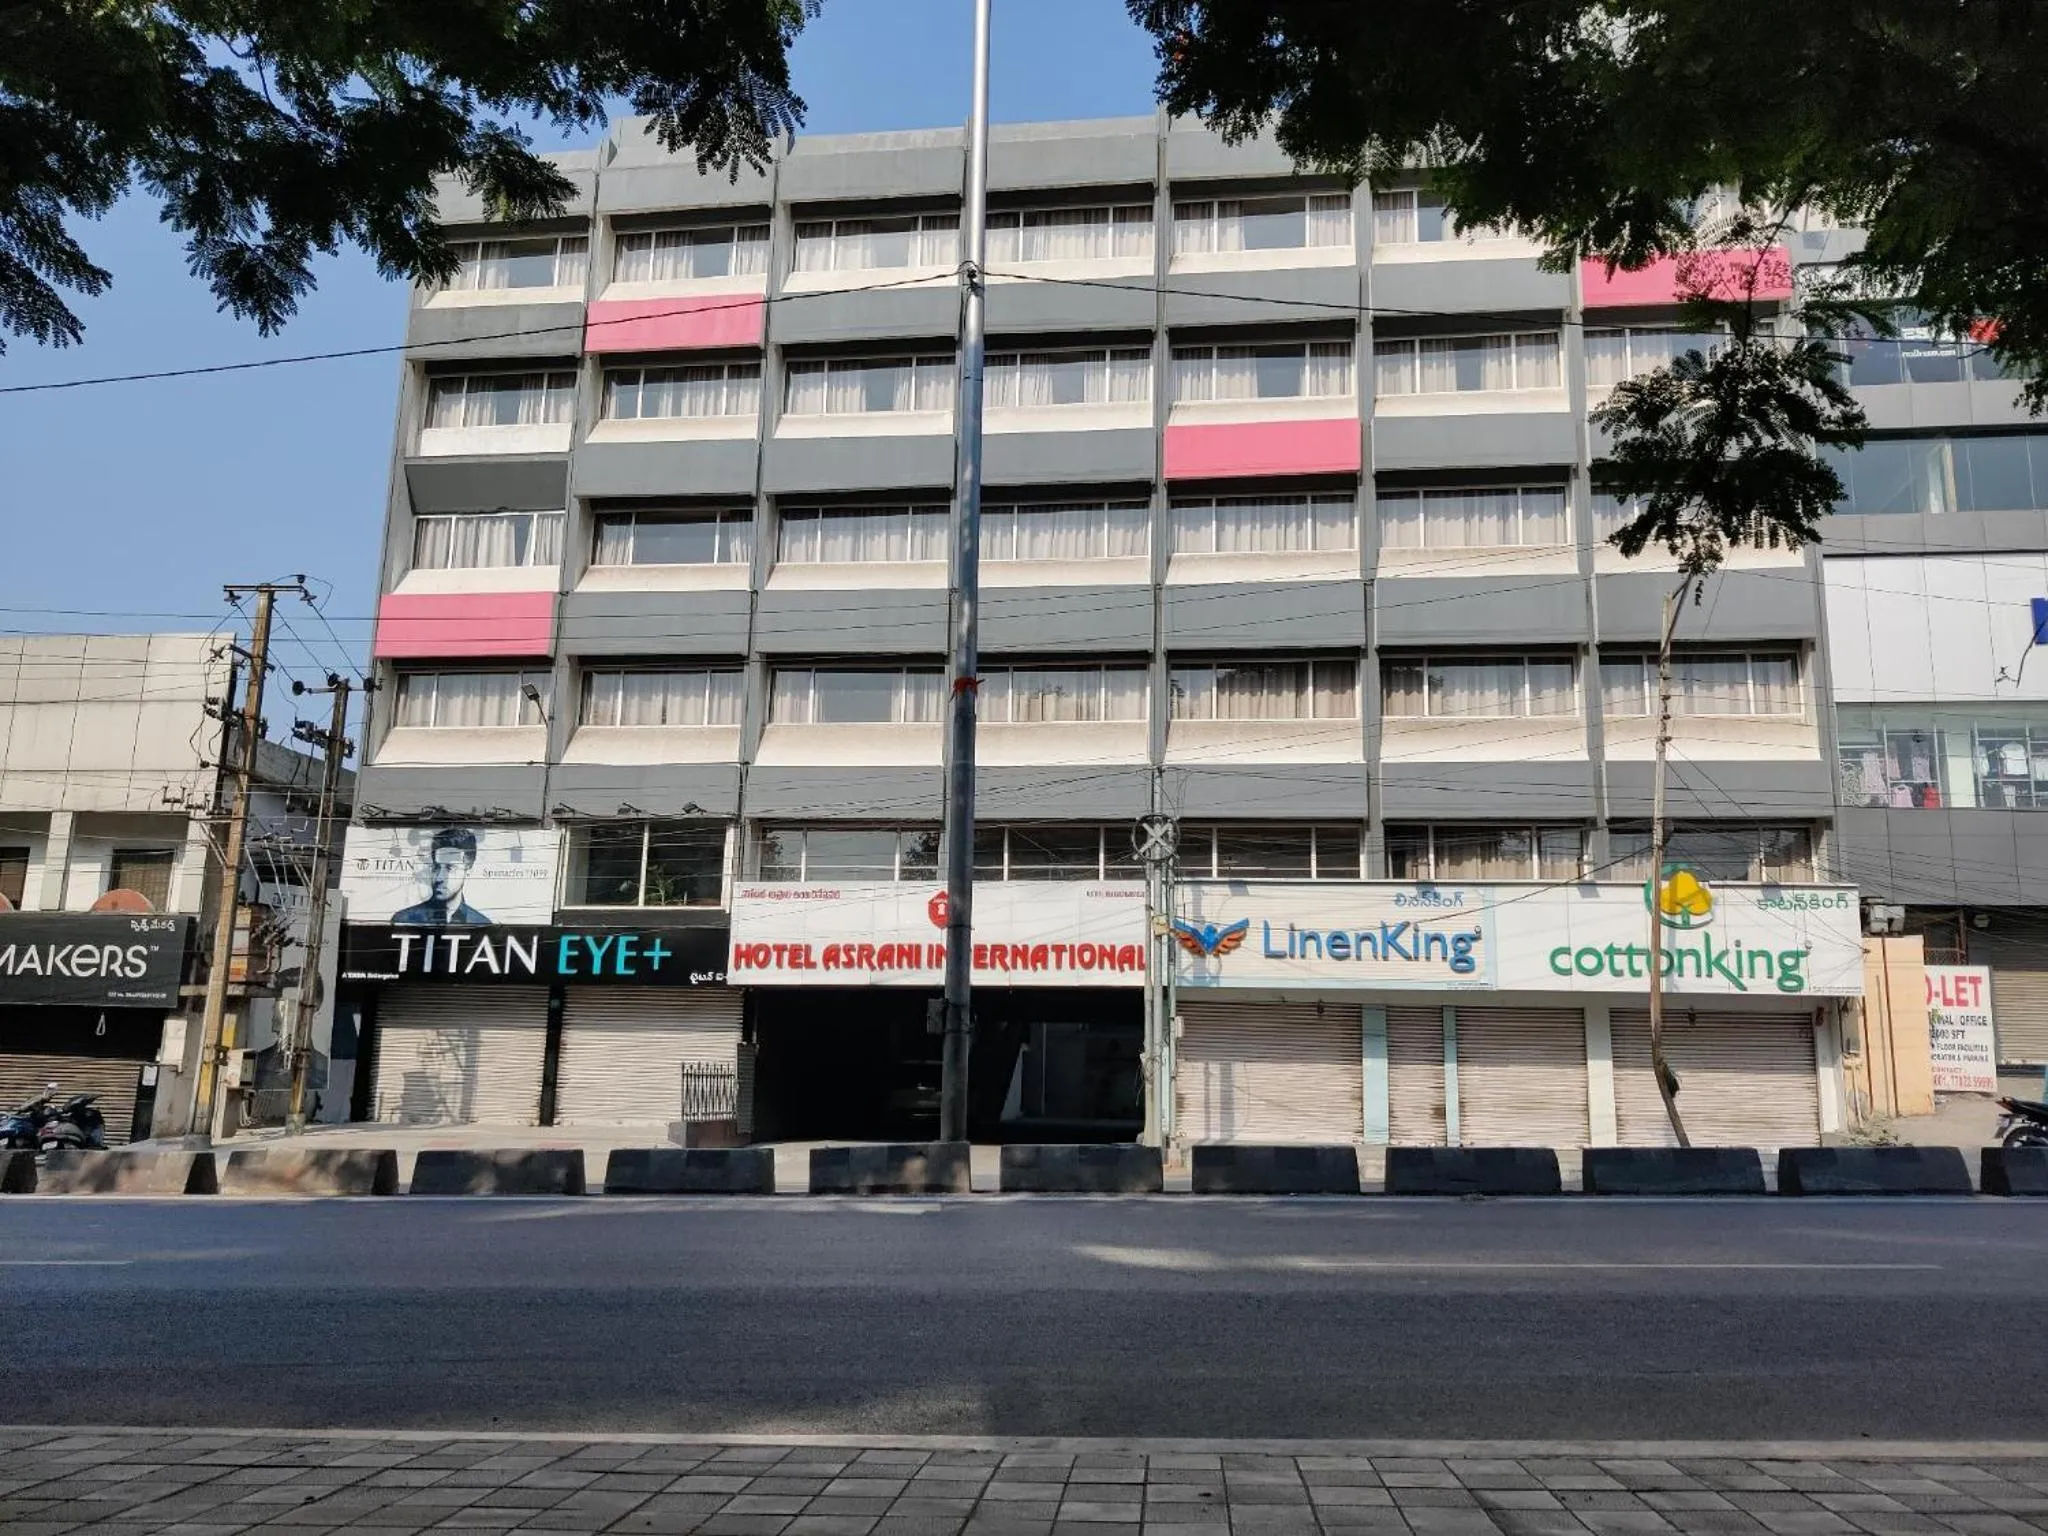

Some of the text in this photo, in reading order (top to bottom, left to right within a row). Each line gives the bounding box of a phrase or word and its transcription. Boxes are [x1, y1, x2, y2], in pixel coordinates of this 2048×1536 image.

[391, 934, 672, 975] TITAN EYE+
[733, 942, 1146, 973] HOTEL ASRANI INERNATIONAL
[1264, 920, 1482, 974] LinenKing
[1549, 931, 1808, 992] cottonking
[1960, 1015, 1989, 1026] OFFICE
